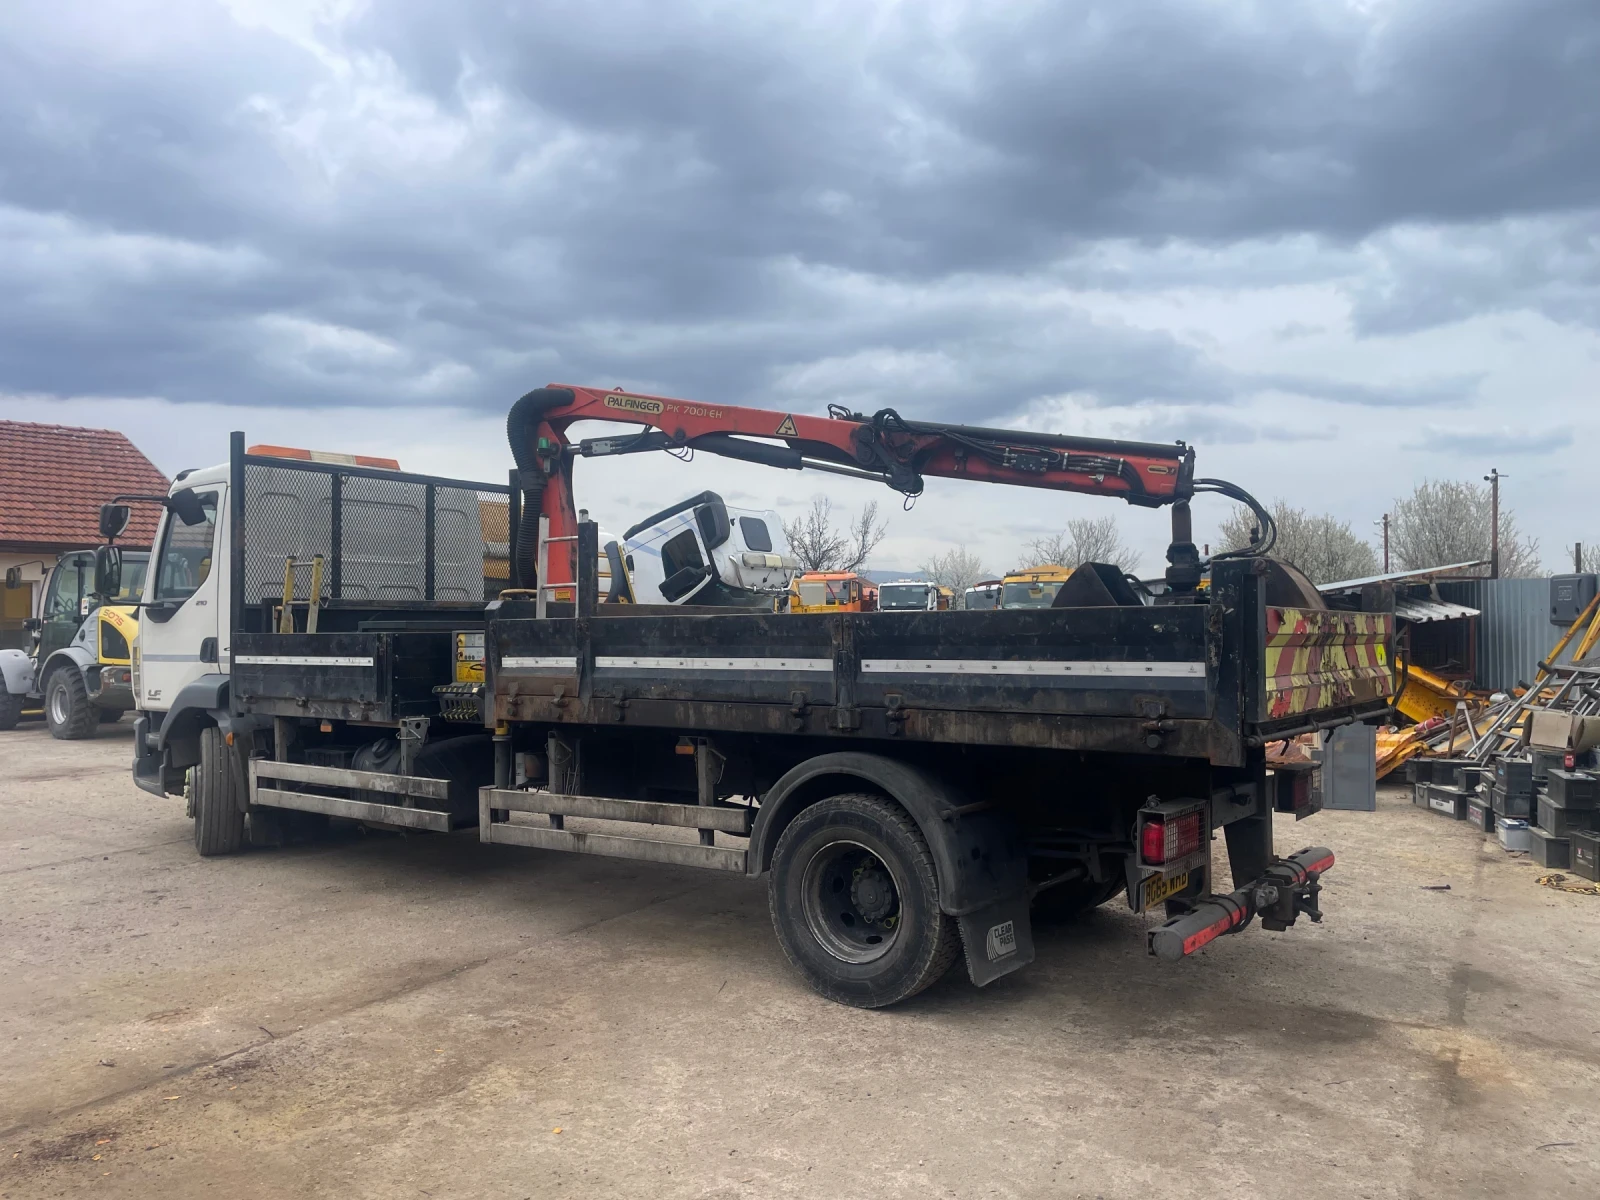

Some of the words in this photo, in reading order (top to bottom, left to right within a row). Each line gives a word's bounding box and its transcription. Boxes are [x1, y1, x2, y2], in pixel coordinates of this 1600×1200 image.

[607, 396, 660, 412] PALFINGER
[666, 404, 680, 413] PK
[103, 609, 124, 626] 5075
[148, 689, 162, 697] LF
[994, 923, 1012, 938] CLEAR
[1000, 933, 1014, 947] PASS
